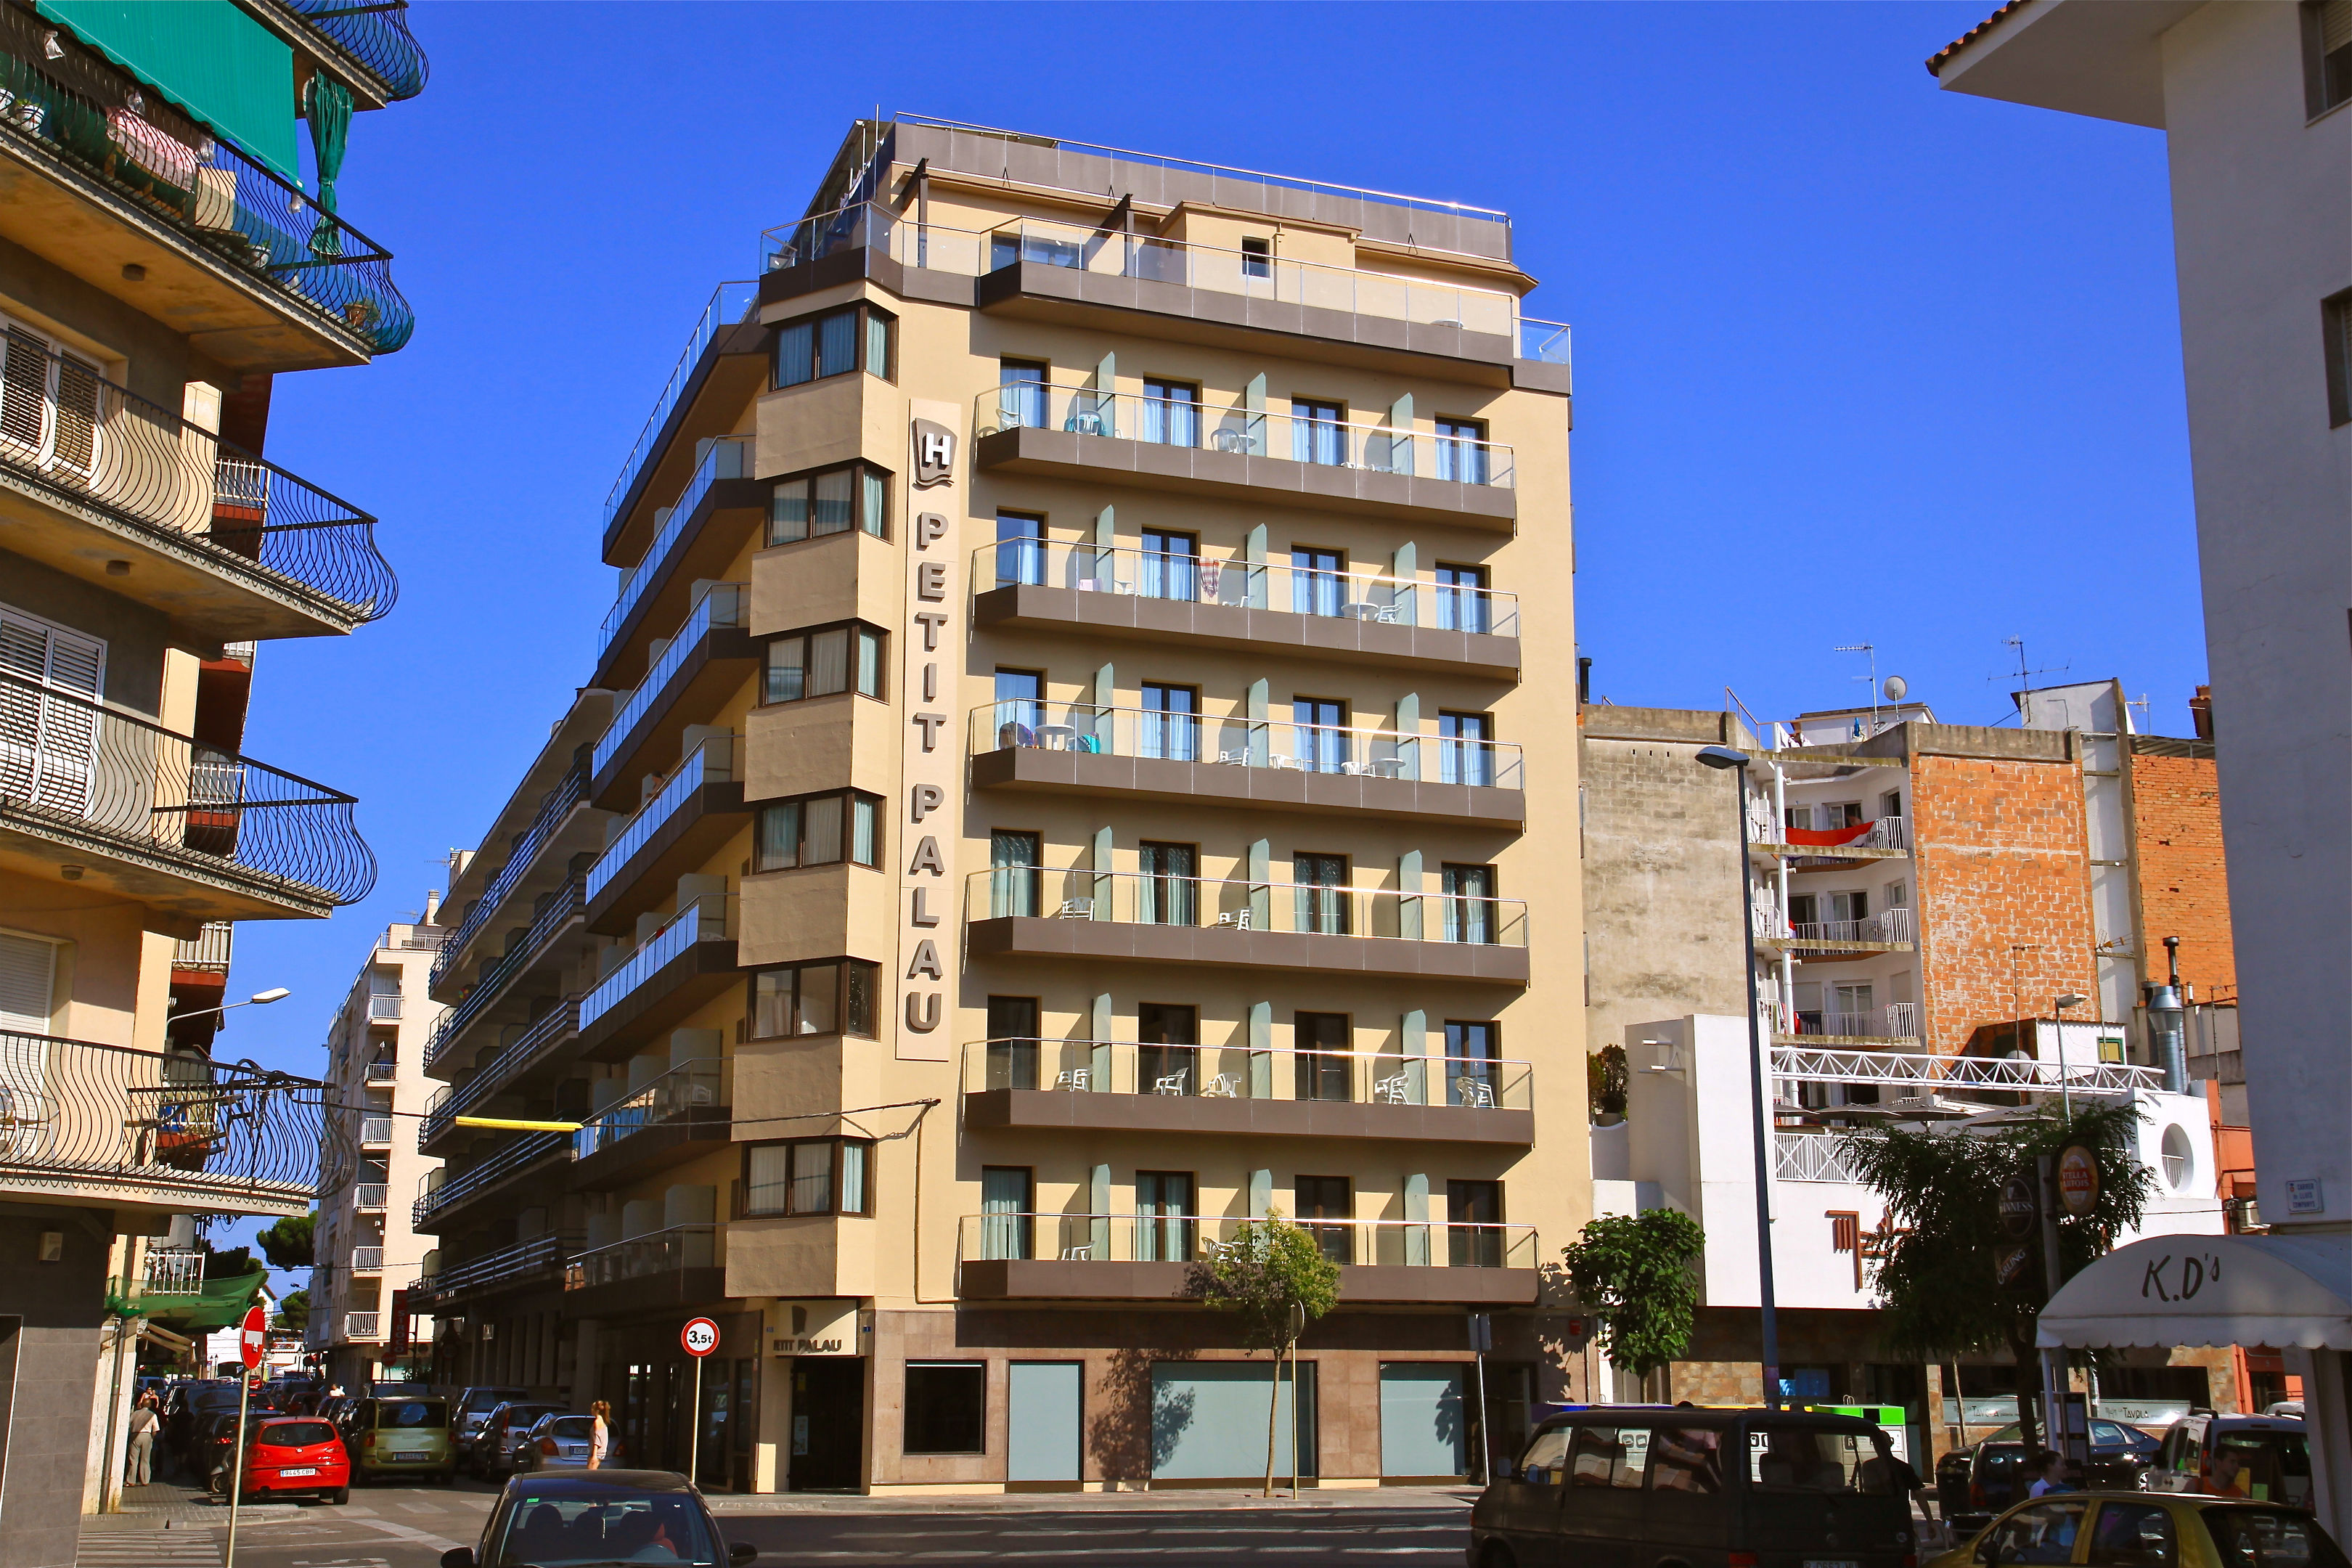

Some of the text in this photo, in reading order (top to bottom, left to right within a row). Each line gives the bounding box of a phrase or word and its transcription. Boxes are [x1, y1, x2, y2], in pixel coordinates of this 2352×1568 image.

[925, 432, 952, 467] H
[909, 511, 950, 1031] PETIT PALAU
[1999, 1201, 2034, 1213] INNESS
[394, 1310, 406, 1353] SIROCO
[797, 1339, 842, 1352] PALAU
